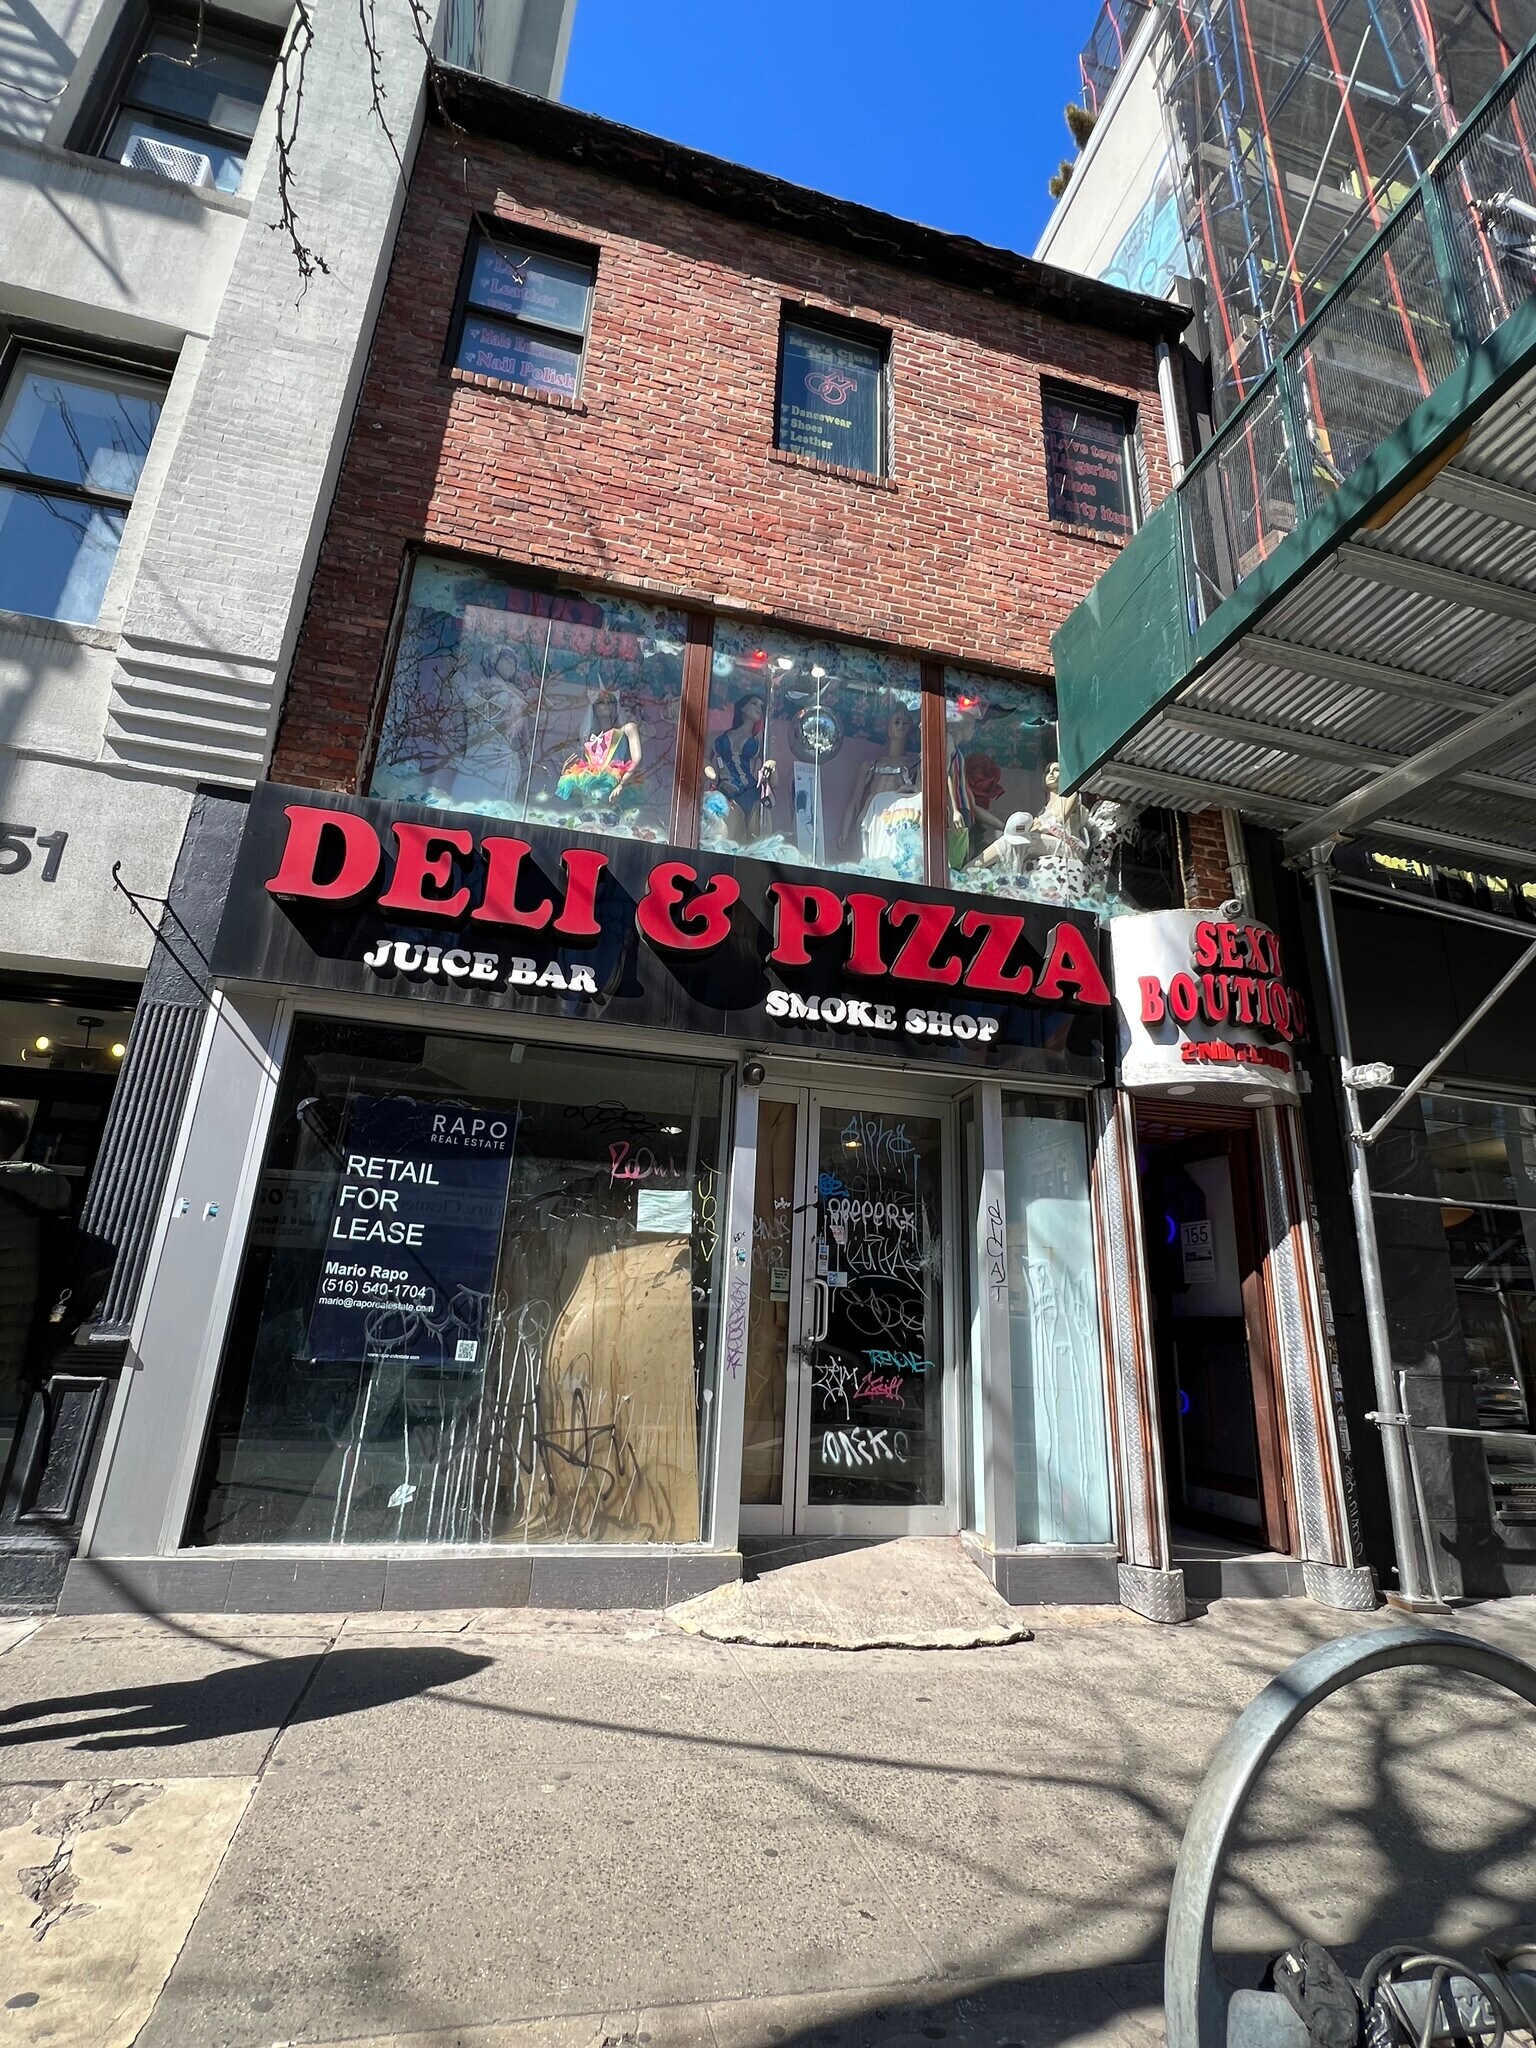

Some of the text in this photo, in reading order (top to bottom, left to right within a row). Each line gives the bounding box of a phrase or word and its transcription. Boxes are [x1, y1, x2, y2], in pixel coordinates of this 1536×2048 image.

[480, 328, 513, 349] Male
[789, 335, 833, 355] Men's
[476, 351, 575, 390] Nail Polish
[791, 403, 852, 429] Dancewear
[791, 418, 823, 434] Shoes
[790, 431, 833, 450] Leather
[1052, 451, 1118, 482] Lingeries
[1092, 444, 1122, 465] toys
[1056, 495, 1097, 520] Party
[264, 804, 1112, 1006] DELI & PIZZA
[1194, 920, 1283, 977] SEXY
[363, 940, 599, 994] JUICE BAR
[765, 988, 999, 1043] SMOKE SHOP
[1138, 971, 1311, 1042] BOUTIQU
[1180, 1041, 1235, 1064] 2ND
[432, 1114, 508, 1139] RAPO
[430, 1133, 506, 1150] REAL ESTATE
[346, 1154, 440, 1185] RETAIL
[339, 1185, 400, 1212] FOR
[332, 1216, 425, 1246] LEASE
[1184, 1225, 1209, 1244] 155
[325, 1261, 409, 1282] Mario Rapo
[322, 1278, 427, 1299] (516) 540-1704
[318, 1296, 435, 1313] mario@raporealestate.com
